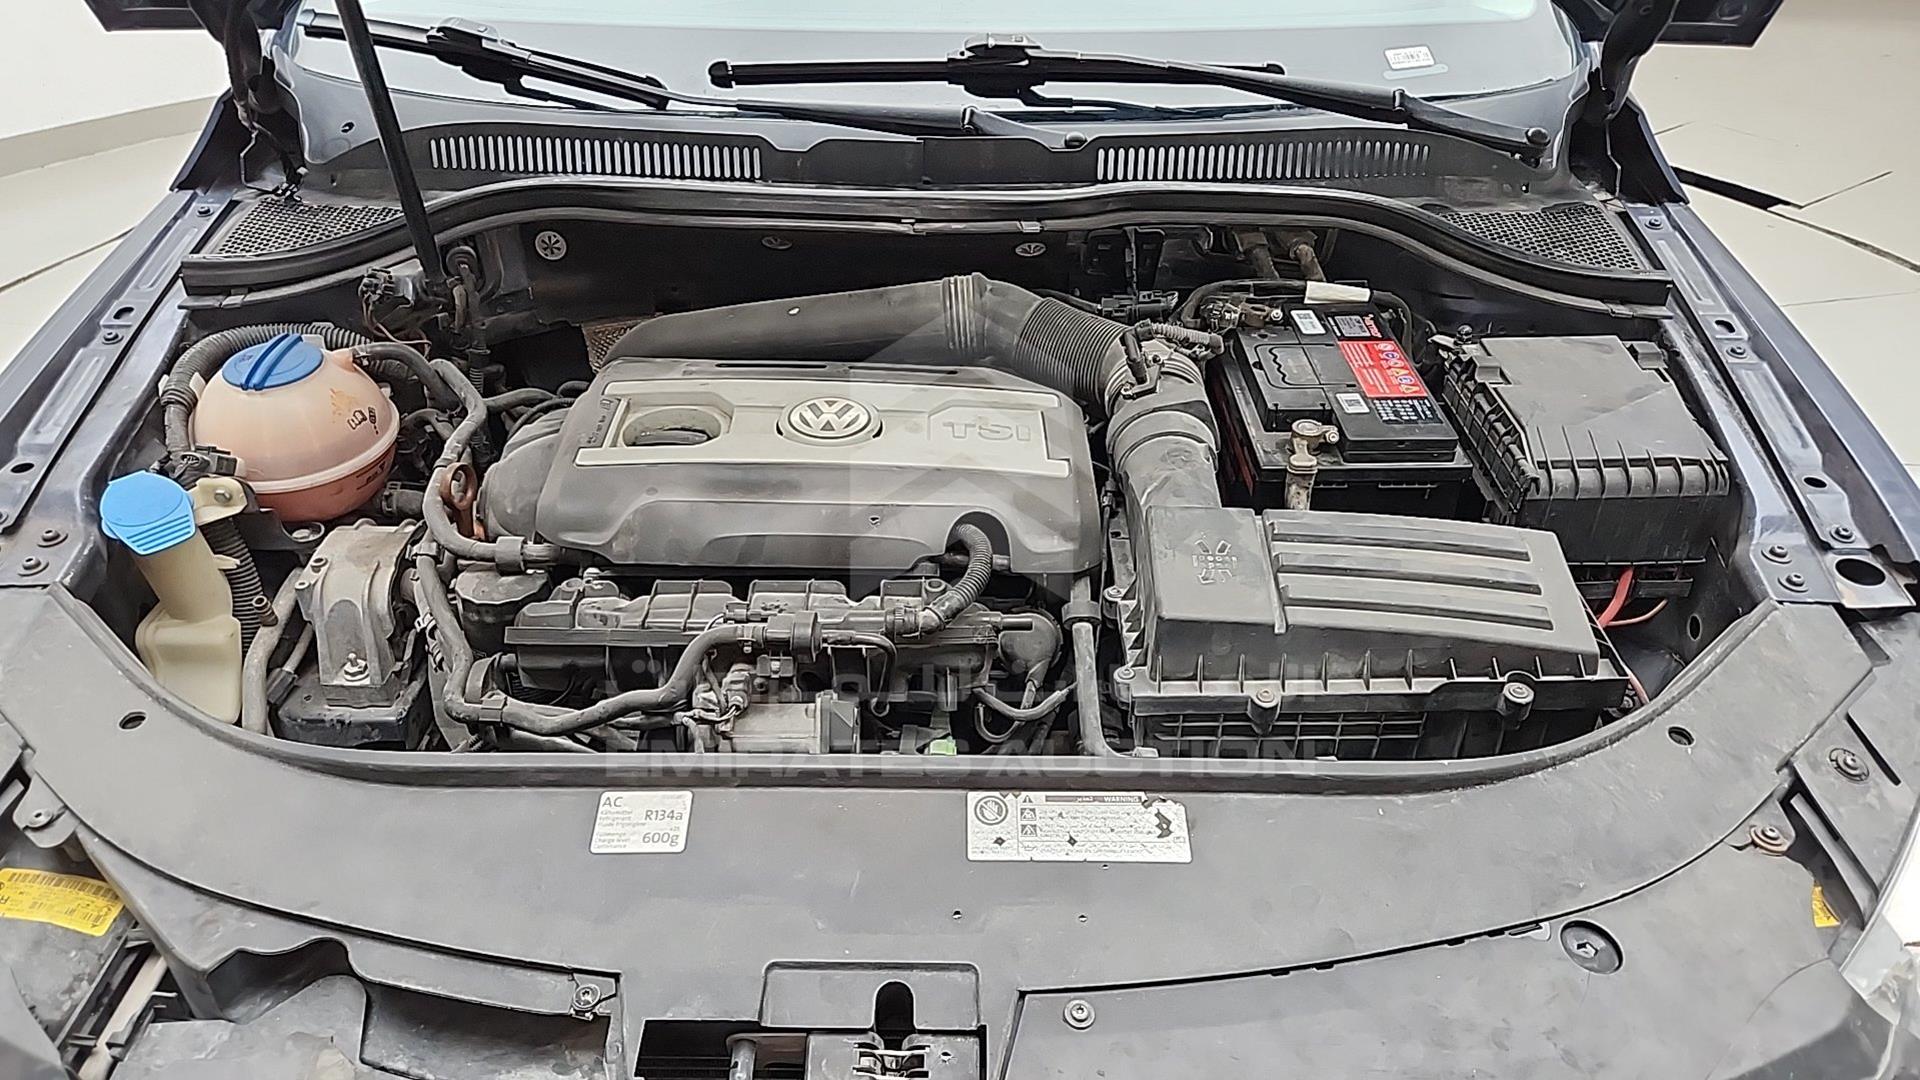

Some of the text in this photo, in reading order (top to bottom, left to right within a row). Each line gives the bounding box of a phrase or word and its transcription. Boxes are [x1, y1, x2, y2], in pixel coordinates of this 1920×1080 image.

[942, 421, 1032, 442] TSI
[602, 796, 623, 808] AC
[1103, 795, 1139, 803] WARNING
[644, 809, 683, 821] R134a
[642, 832, 679, 847] 600g
